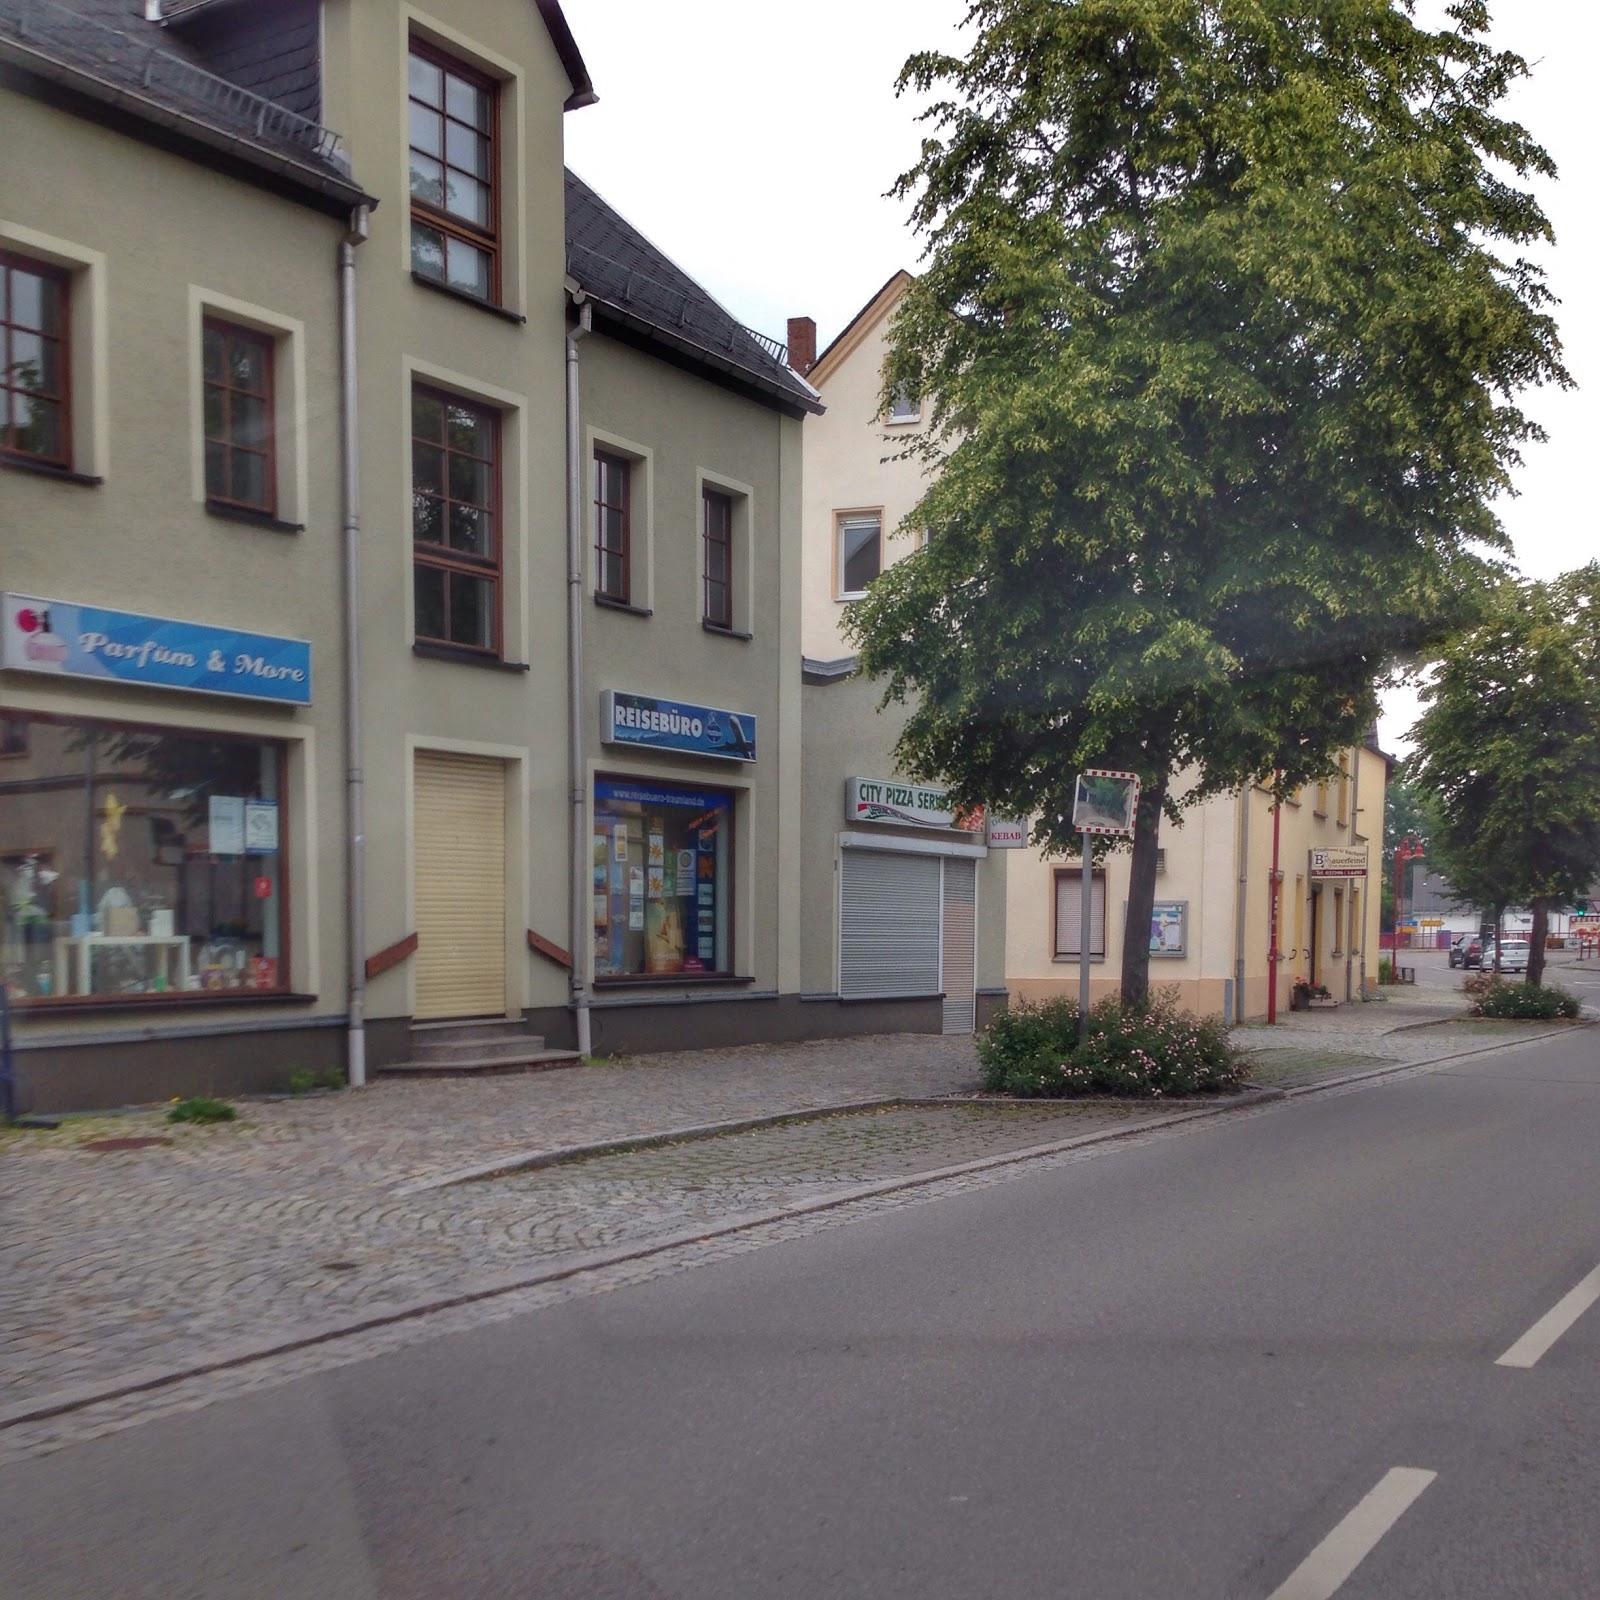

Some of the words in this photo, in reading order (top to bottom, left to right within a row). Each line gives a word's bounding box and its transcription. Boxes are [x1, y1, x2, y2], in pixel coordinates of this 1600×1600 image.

[80, 632, 197, 667] Parfüm
[207, 650, 225, 673] &
[234, 654, 305, 682] More
[615, 705, 703, 738] REISEBÜRO
[860, 784, 882, 803] CITY
[886, 788, 914, 808] PIZZA
[991, 832, 1022, 841] KEBAB
